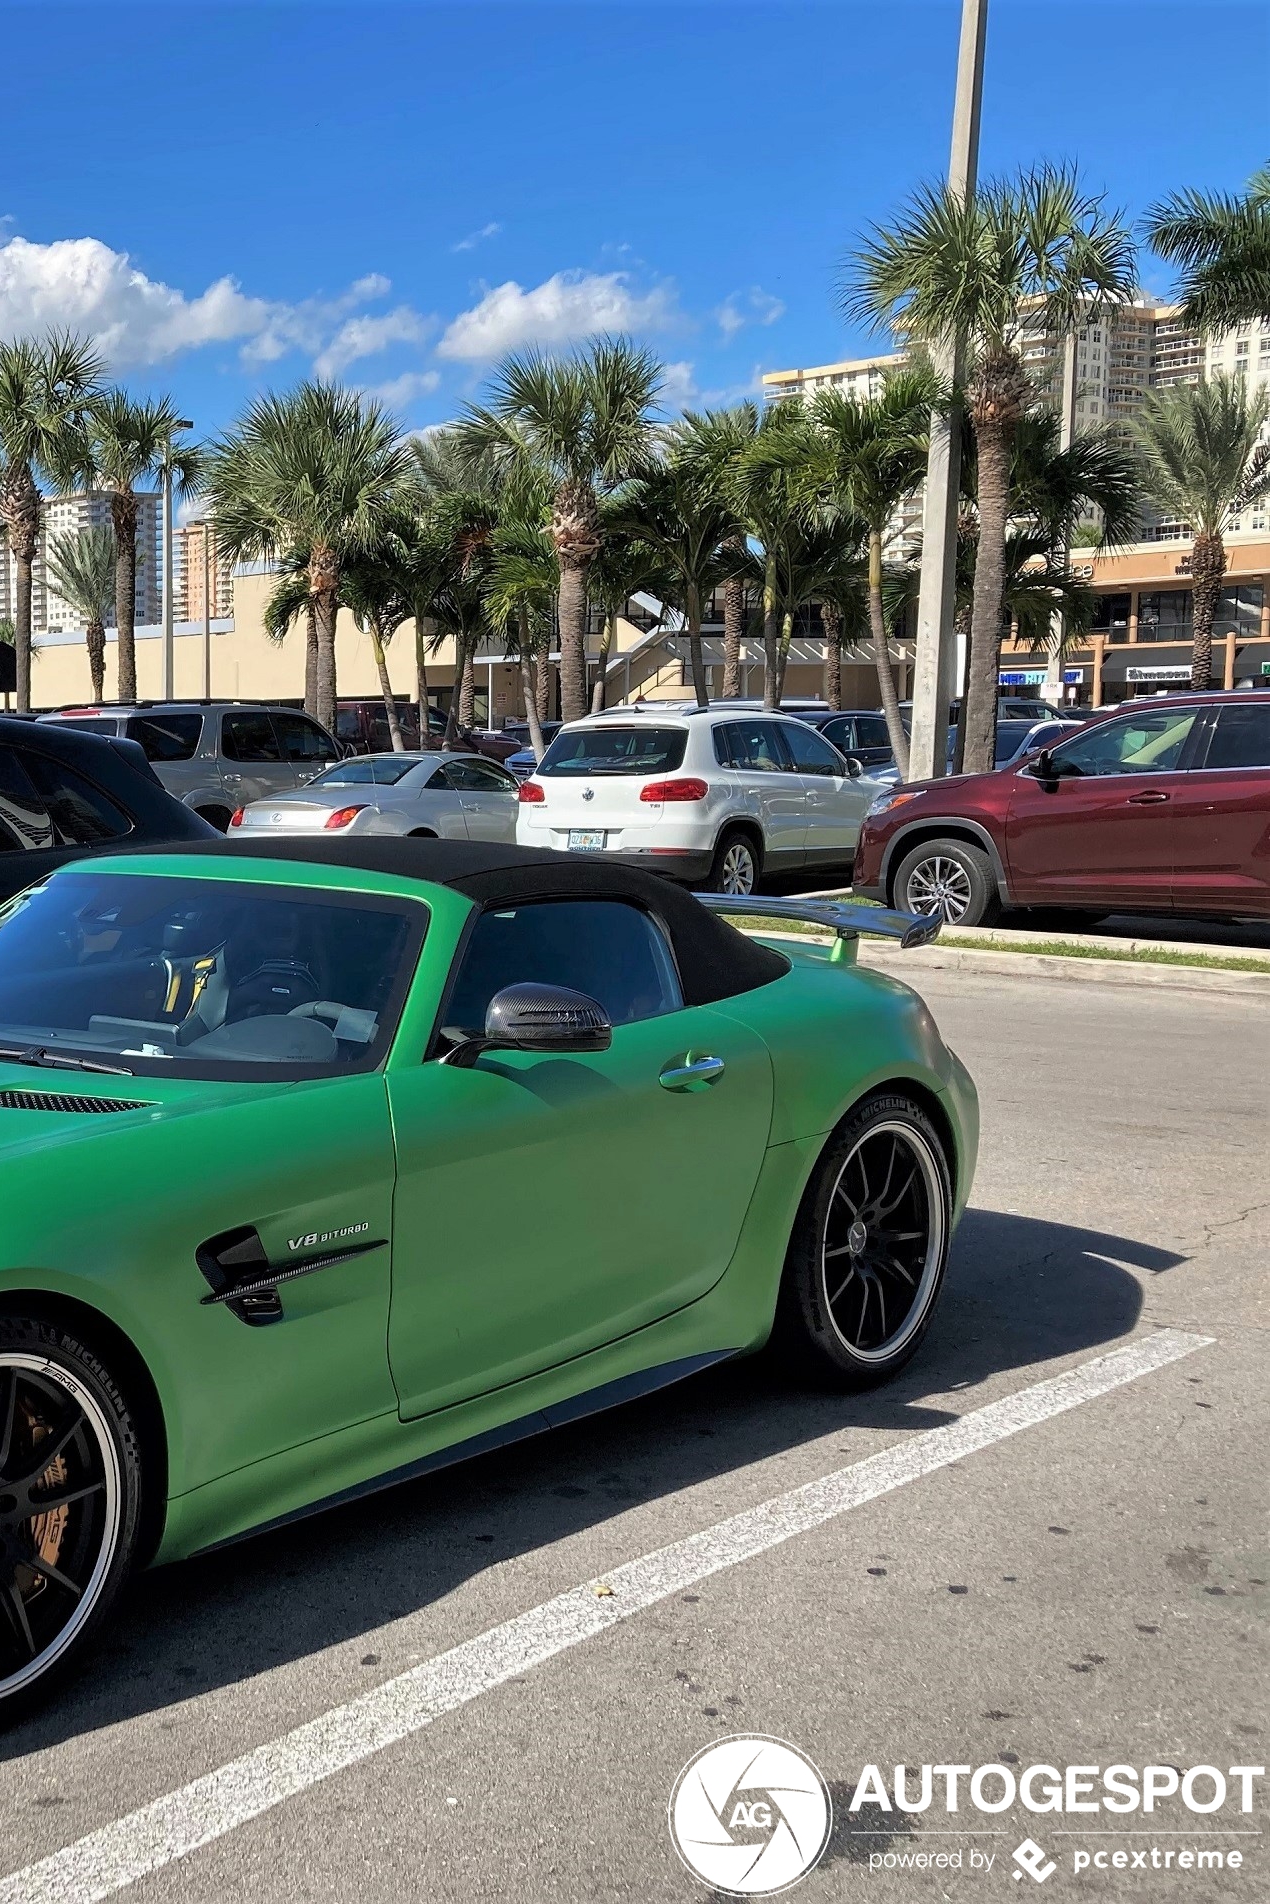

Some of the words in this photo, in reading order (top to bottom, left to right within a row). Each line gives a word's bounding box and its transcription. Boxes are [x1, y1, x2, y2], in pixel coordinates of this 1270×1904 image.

[861, 1098, 906, 1122] MICHELIN
[287, 1232, 318, 1251] V8
[320, 1221, 370, 1242] BITURBO
[51, 1371, 79, 1393] AMG
[61, 1335, 127, 1413] MICHELIN
